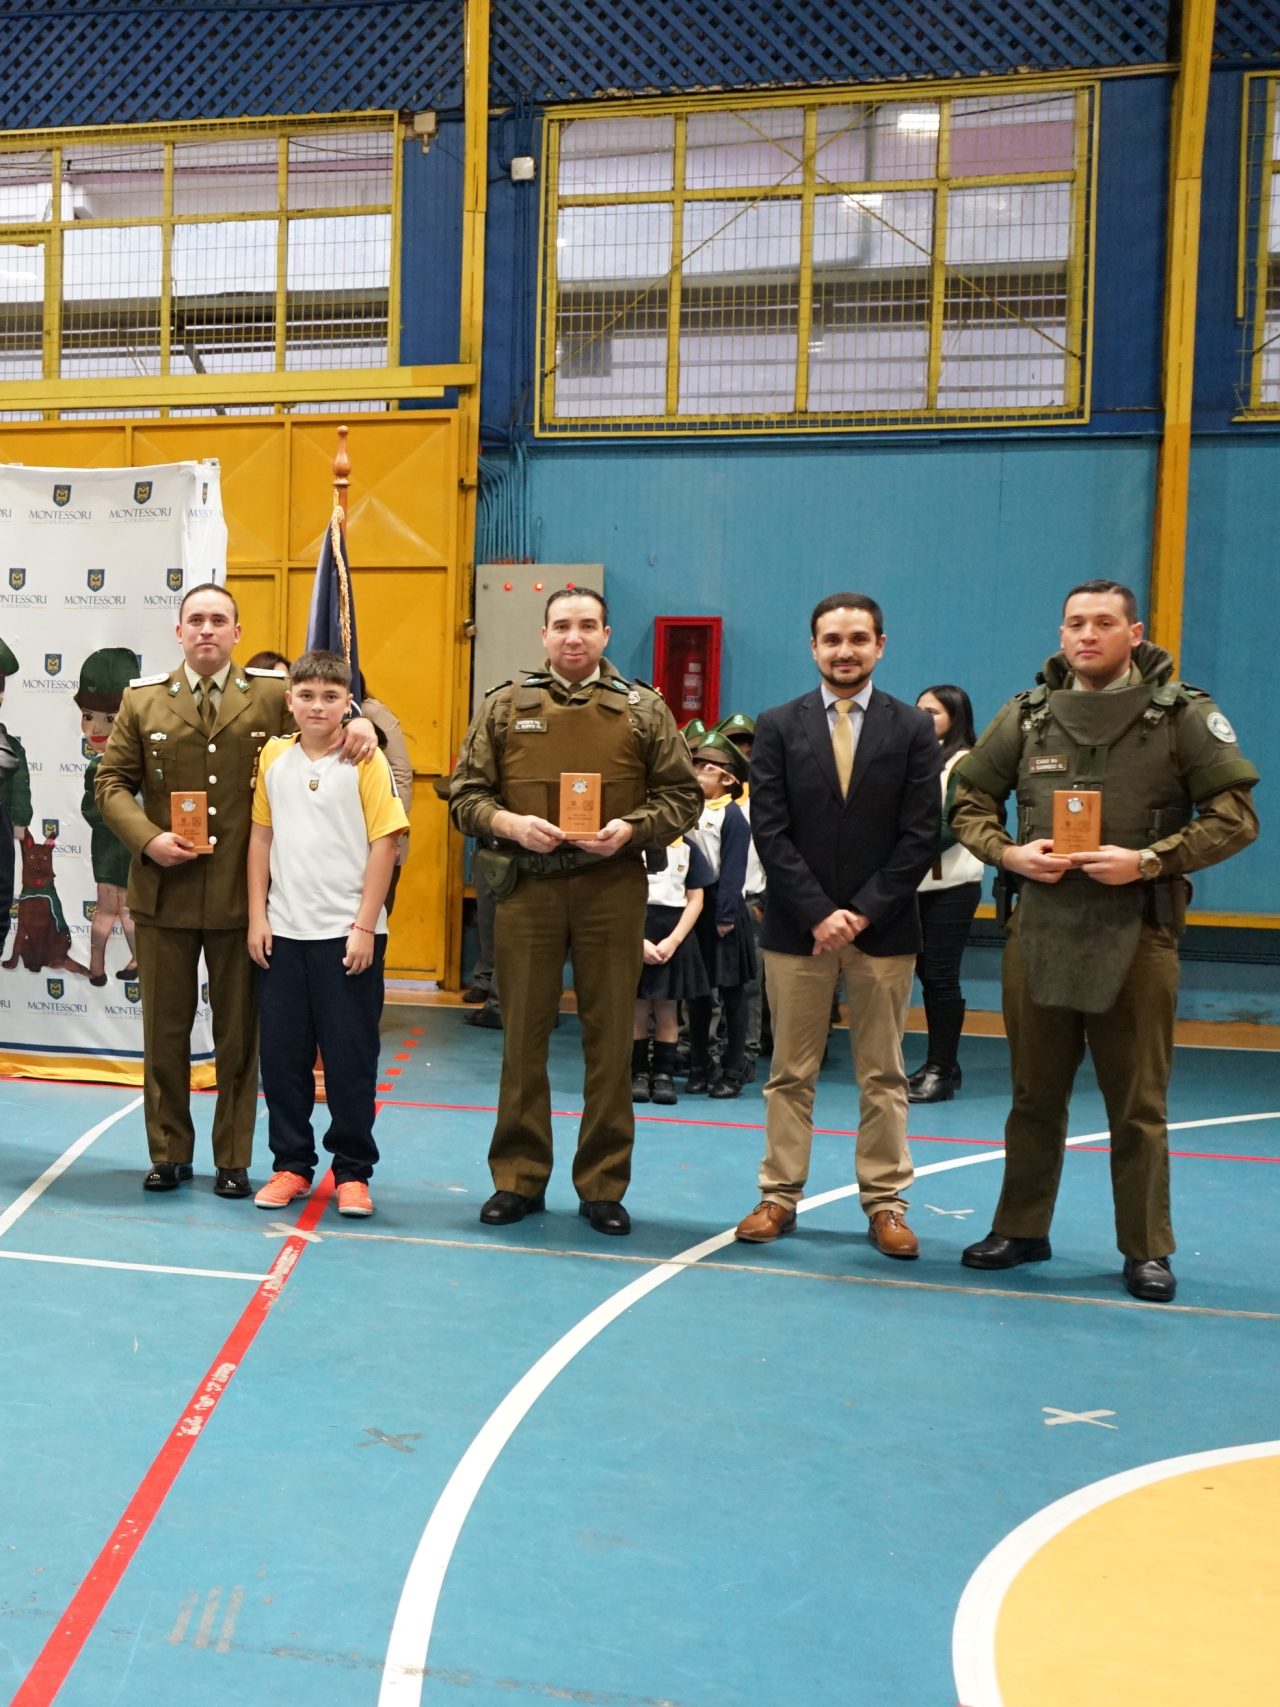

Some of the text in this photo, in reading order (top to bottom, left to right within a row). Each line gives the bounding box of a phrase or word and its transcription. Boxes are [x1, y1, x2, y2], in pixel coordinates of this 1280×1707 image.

[29, 510, 92, 520] MONTESSORI
[109, 507, 172, 518] MONTESSORI
[64, 595, 126, 605] MONTESSORI
[144, 595, 183, 605] MONTES
[23, 680, 78, 689] MONTESSOR
[28, 1001, 88, 1012] MONTESSORI
